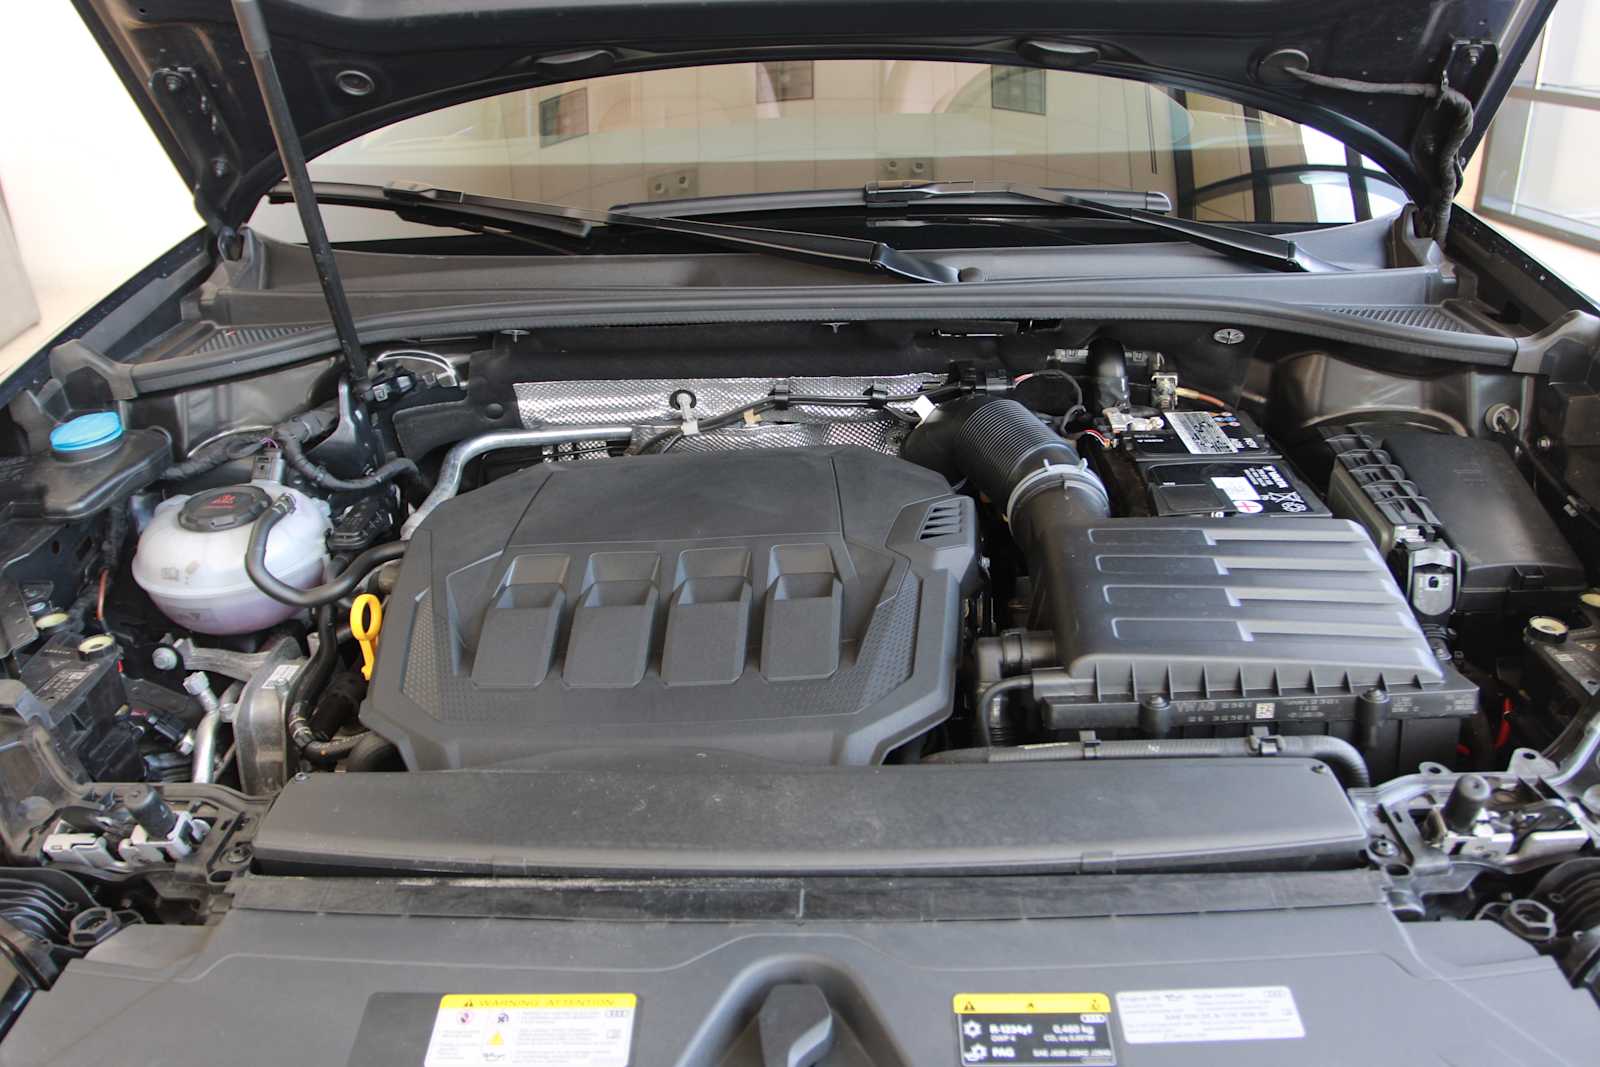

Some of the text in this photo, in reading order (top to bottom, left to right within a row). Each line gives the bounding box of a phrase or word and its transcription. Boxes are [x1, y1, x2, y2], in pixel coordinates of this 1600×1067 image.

[1262, 465, 1289, 488] VARTA
[479, 999, 616, 1007] WARNING ATTENTION
[992, 1047, 1015, 1058] PAG
